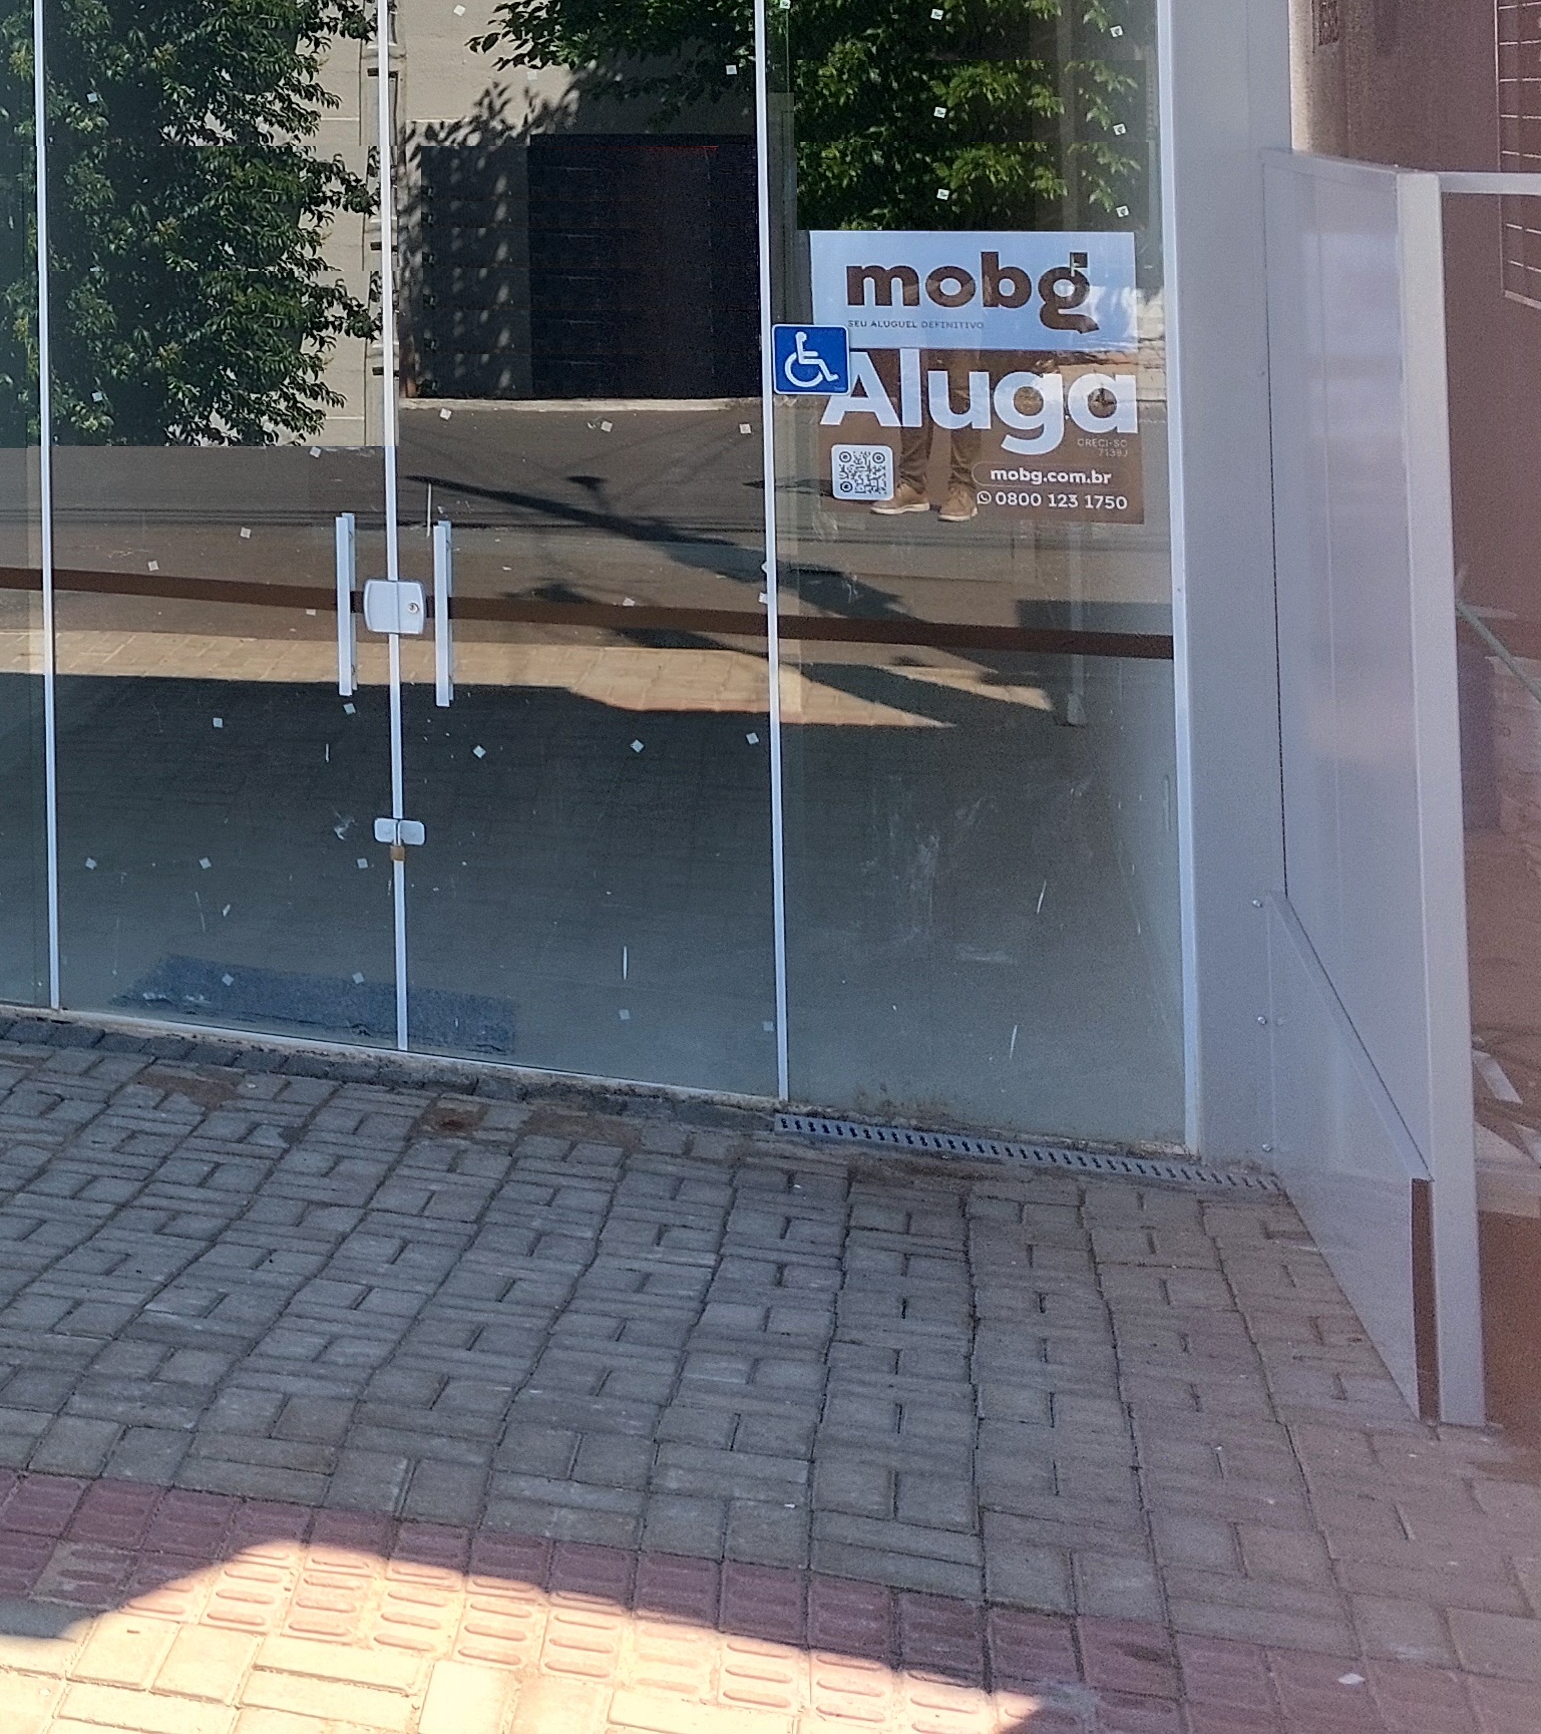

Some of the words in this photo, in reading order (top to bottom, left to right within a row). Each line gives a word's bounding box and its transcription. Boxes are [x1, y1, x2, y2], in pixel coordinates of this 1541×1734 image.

[846, 251, 1100, 334] mobg
[848, 320, 867, 328] SEU
[871, 320, 917, 329] ALUGUEL
[921, 321, 984, 329] DEFINITIVO
[819, 348, 1139, 456] Aluga
[990, 467, 1112, 485] mobg.com.br
[995, 491, 1041, 507] 0800
[1047, 493, 1078, 508] 123
[1084, 494, 1128, 510] 1750
